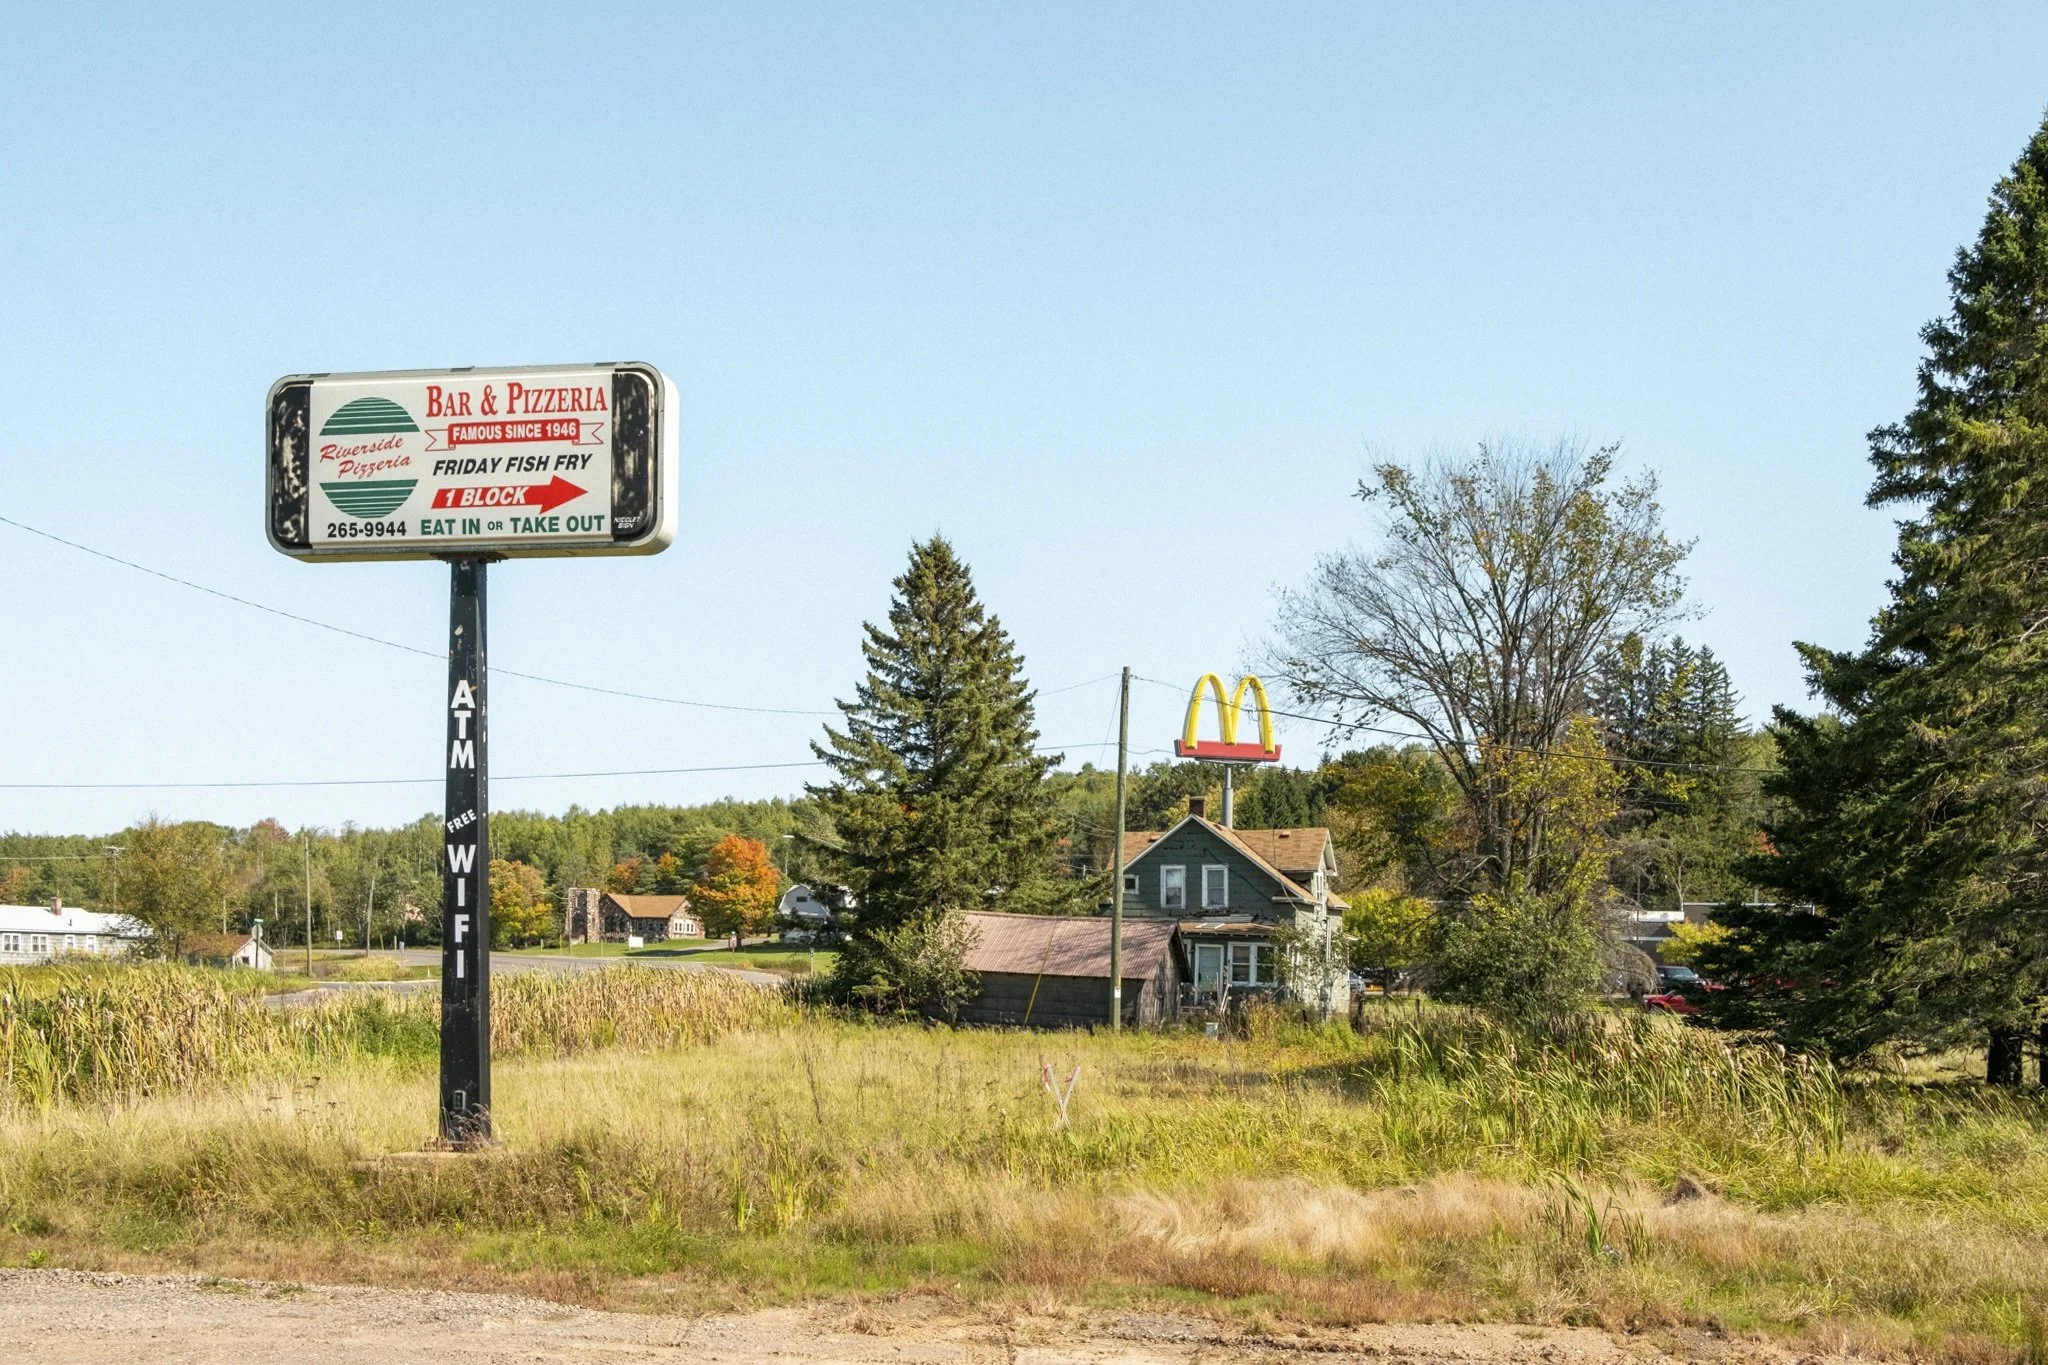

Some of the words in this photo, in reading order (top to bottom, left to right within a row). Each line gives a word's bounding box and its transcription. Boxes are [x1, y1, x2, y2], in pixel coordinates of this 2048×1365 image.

[480, 384, 498, 416] &
[506, 382, 608, 415] PIZZERIA
[452, 426, 502, 441] FAMOUS
[505, 424, 542, 439] SINCE
[545, 422, 577, 437] 1946
[319, 434, 404, 463] Riverside
[338, 455, 412, 479] Pizzeria
[432, 457, 503, 476] FRIDAY
[505, 455, 550, 473] FISH
[554, 453, 593, 471] FRY
[445, 489, 455, 507] 1
[460, 486, 529, 506] BLOCK
[327, 521, 407, 538] 265-9944
[420, 519, 456, 535] EAT
[462, 518, 481, 534] IN
[487, 521, 503, 531] OR
[510, 516, 560, 533] TAKE
[566, 515, 606, 532] OUT
[450, 679, 476, 769] ATM
[446, 808, 477, 834] FREE
[447, 844, 477, 979] WIFI
